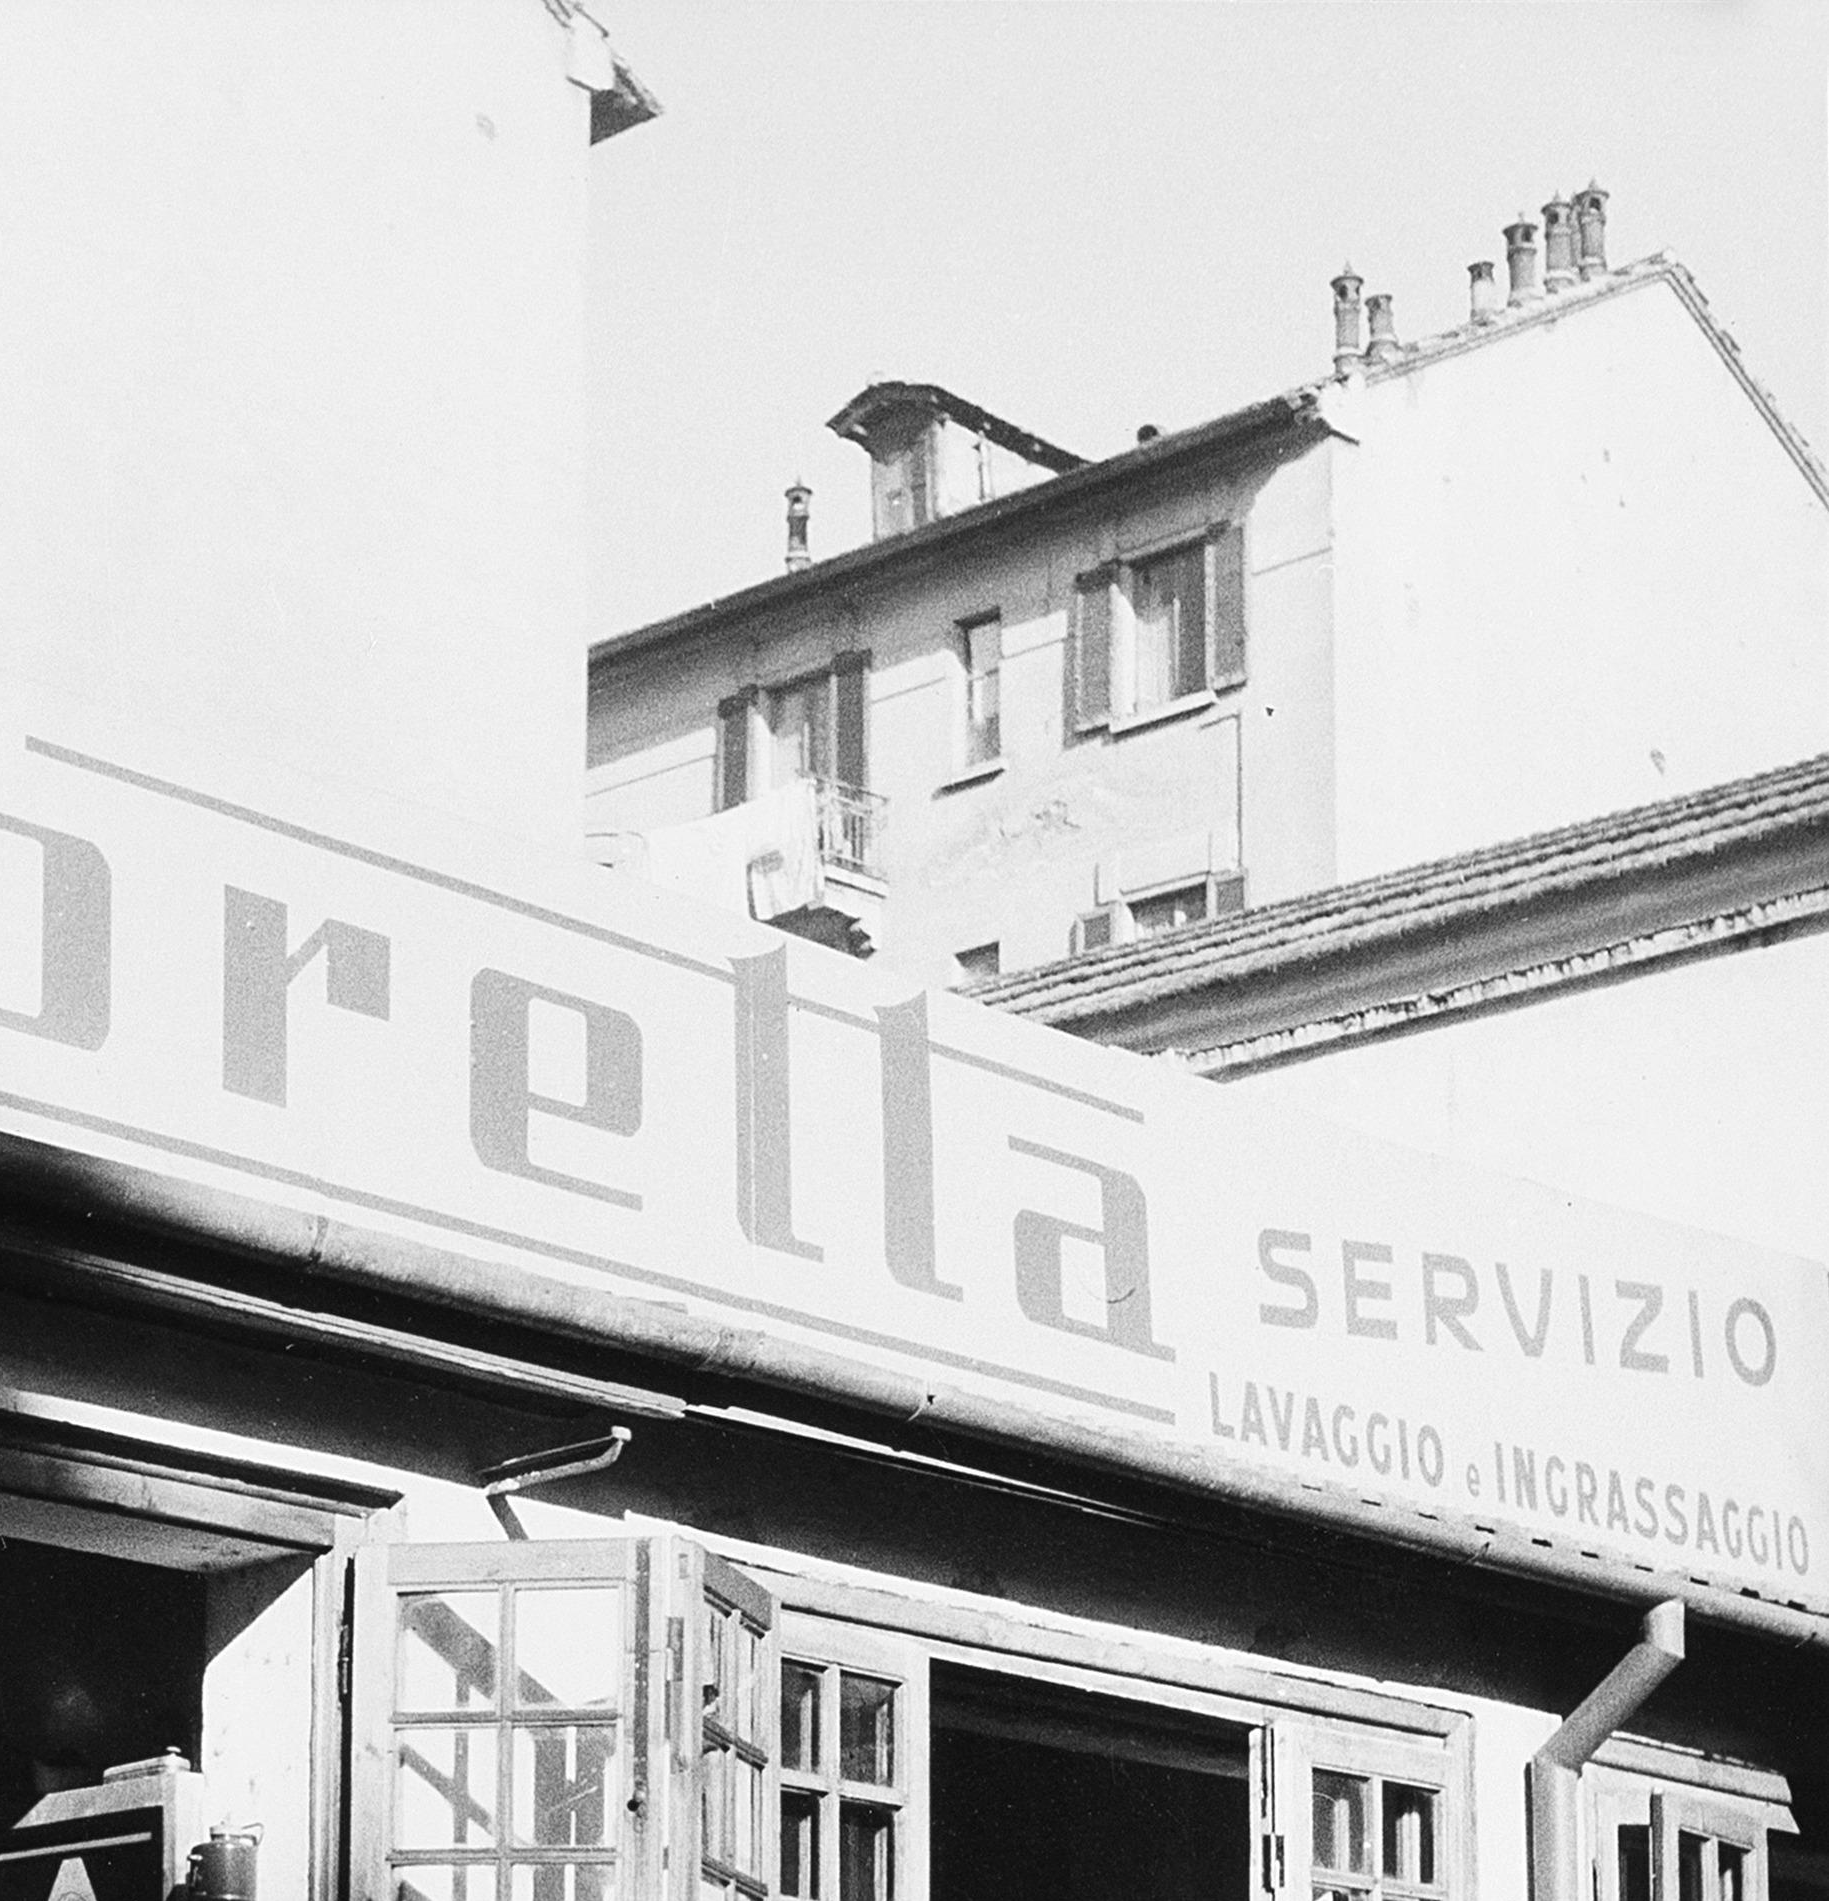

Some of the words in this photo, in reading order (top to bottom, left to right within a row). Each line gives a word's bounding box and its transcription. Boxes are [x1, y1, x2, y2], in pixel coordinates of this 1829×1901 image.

[1257, 1228, 1778, 1388] SERVIZIO
[1209, 1371, 1444, 1488] LAVAGGIO
[1466, 1462, 1480, 1498] e
[1494, 1441, 1809, 1576] INGRASSAGGIO
